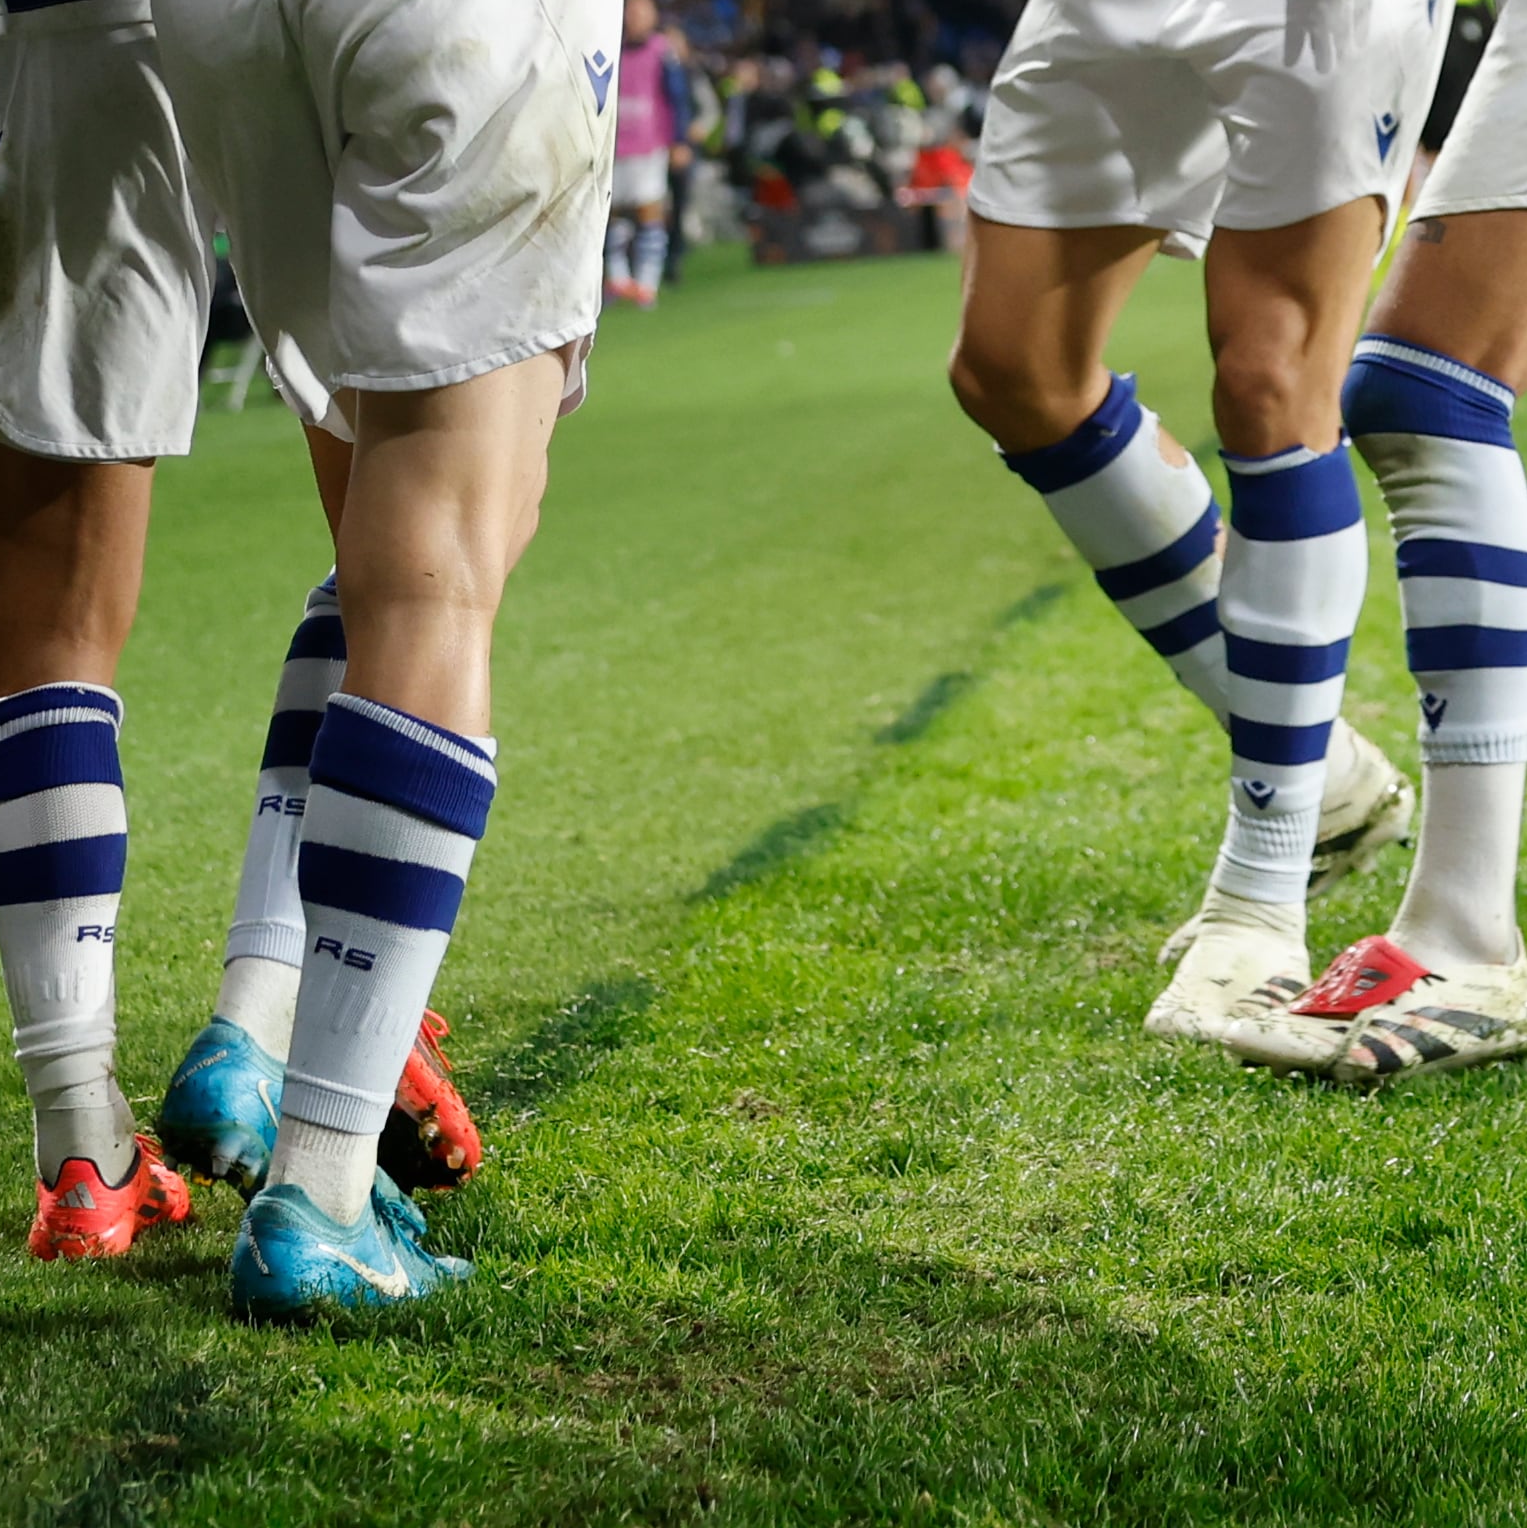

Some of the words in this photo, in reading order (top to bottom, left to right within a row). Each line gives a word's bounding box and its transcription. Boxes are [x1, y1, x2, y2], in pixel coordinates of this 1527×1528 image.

[258, 795, 306, 817] RS
[76, 925, 115, 943] RS
[314, 936, 376, 971] RS
